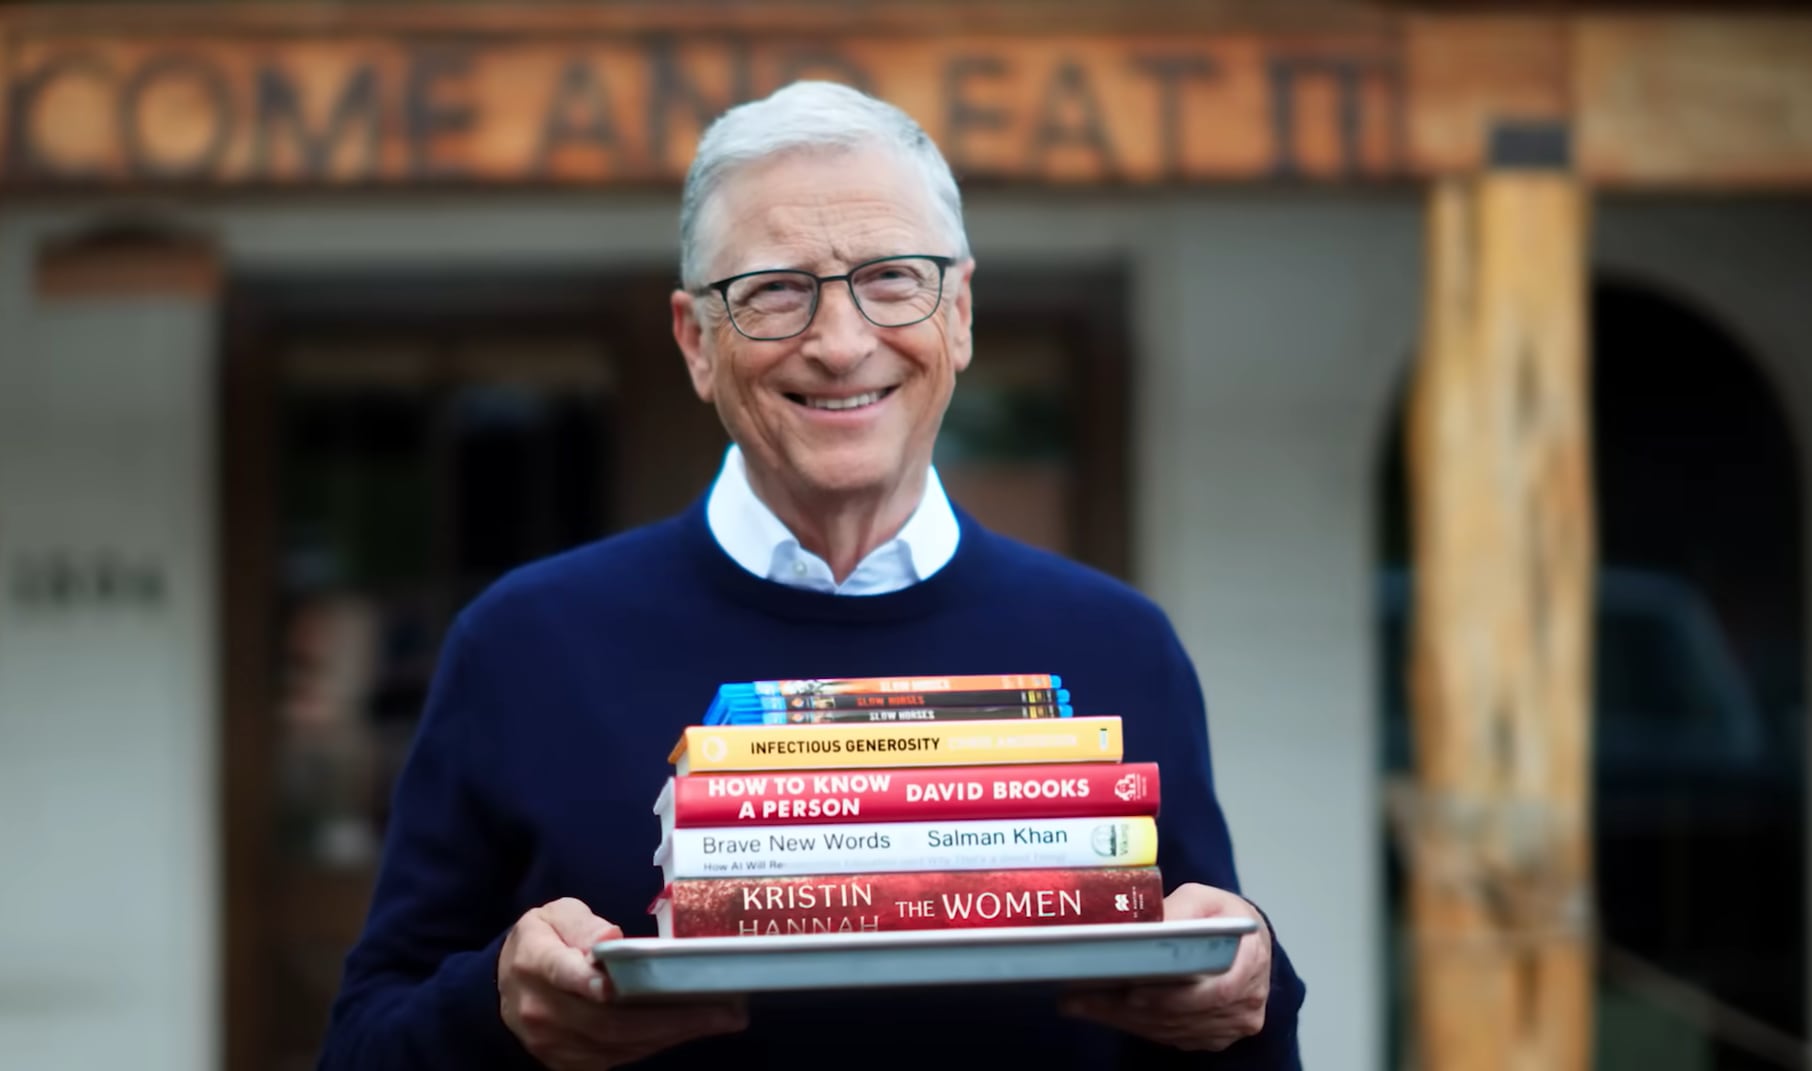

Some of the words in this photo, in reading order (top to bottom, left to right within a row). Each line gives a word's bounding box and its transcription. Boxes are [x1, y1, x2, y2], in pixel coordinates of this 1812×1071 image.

[8, 48, 478, 180] COME
[536, 38, 878, 178] AN
[942, 50, 1215, 178] EAT
[857, 697, 884, 706] SLOW
[869, 711, 896, 721] SLOW
[899, 710, 935, 720] HORSES
[751, 740, 841, 755] INFECTIOUS
[846, 737, 940, 752] GENEROSITY
[708, 778, 767, 797] HOW
[773, 777, 805, 795] TO
[813, 775, 891, 794] KNOW
[906, 782, 983, 802] DAVID
[993, 779, 1090, 799] BROOKS
[738, 801, 756, 819] A
[763, 798, 860, 818] PERSON
[703, 836, 761, 854] Brave
[769, 834, 816, 851] New
[823, 832, 891, 850] Words
[928, 829, 1005, 848] Salman
[1013, 827, 1067, 845] Khan
[703, 862, 728, 871] How
[731, 861, 743, 870] AI
[746, 860, 766, 870] Will
[743, 883, 872, 910] KRISTIN
[895, 900, 935, 918] THE
[942, 889, 1082, 919] WOMEN
[739, 915, 879, 937] HANNAH
